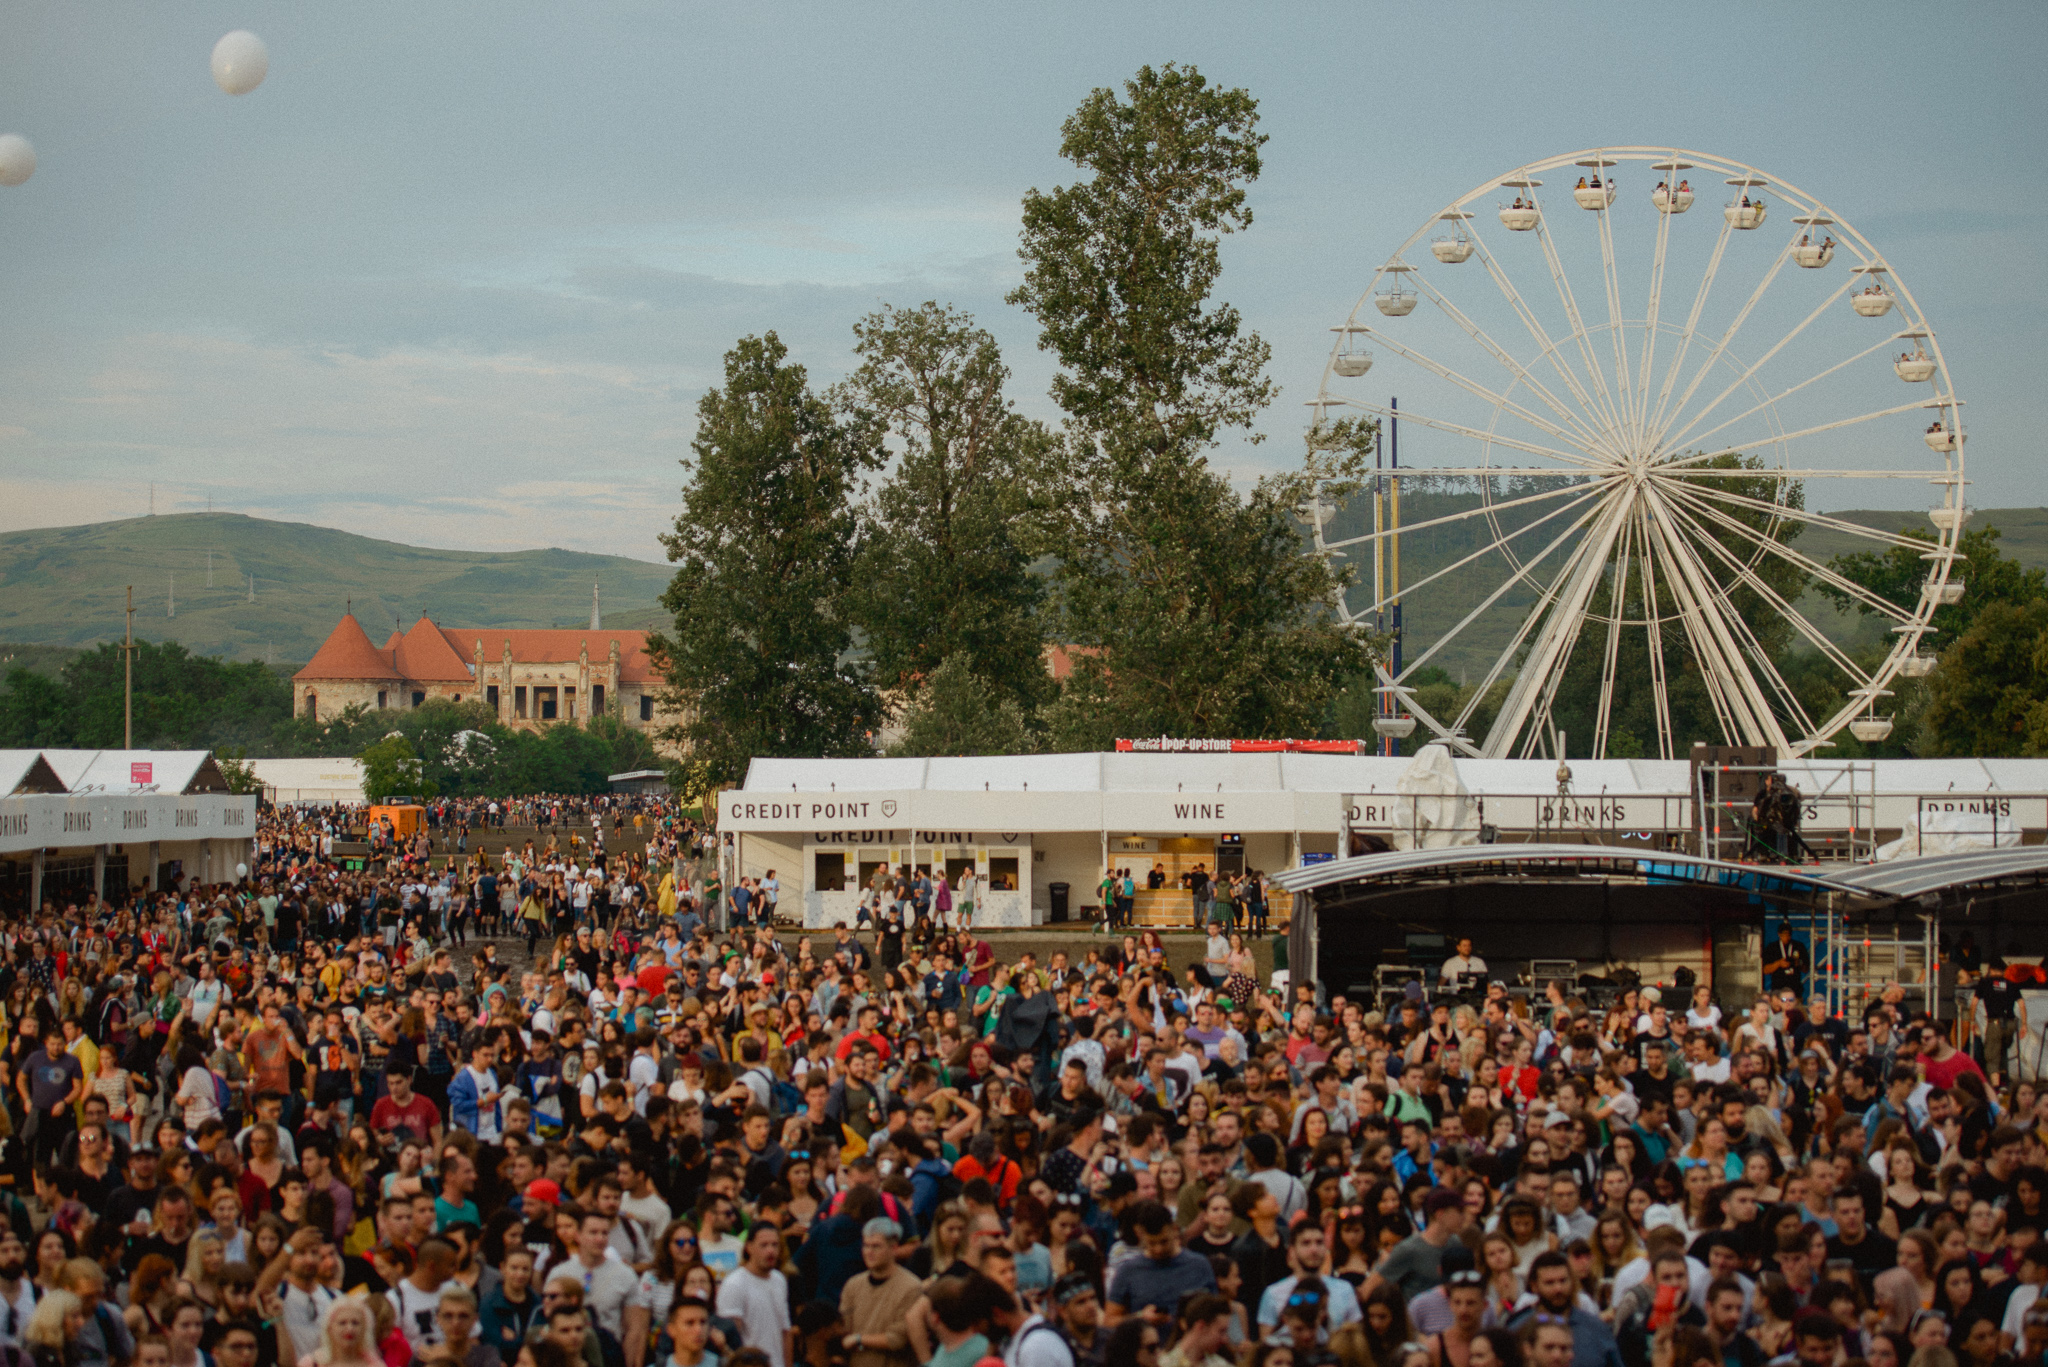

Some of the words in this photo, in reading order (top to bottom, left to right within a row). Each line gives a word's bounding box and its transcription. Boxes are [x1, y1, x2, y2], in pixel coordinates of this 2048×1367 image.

[176, 808, 198, 828] DRINKS
[224, 808, 244, 826] DRINKS
[731, 803, 802, 819] CREDIT
[812, 803, 870, 818] POINT
[1174, 804, 1225, 819] WINE
[1350, 805, 1394, 821] DRI
[1543, 805, 1625, 821] DRINKS
[63, 811, 91, 833] DRINKS
[123, 809, 147, 830] DRINKS
[915, 831, 973, 843] OIN
[1122, 841, 1147, 850] WINE
